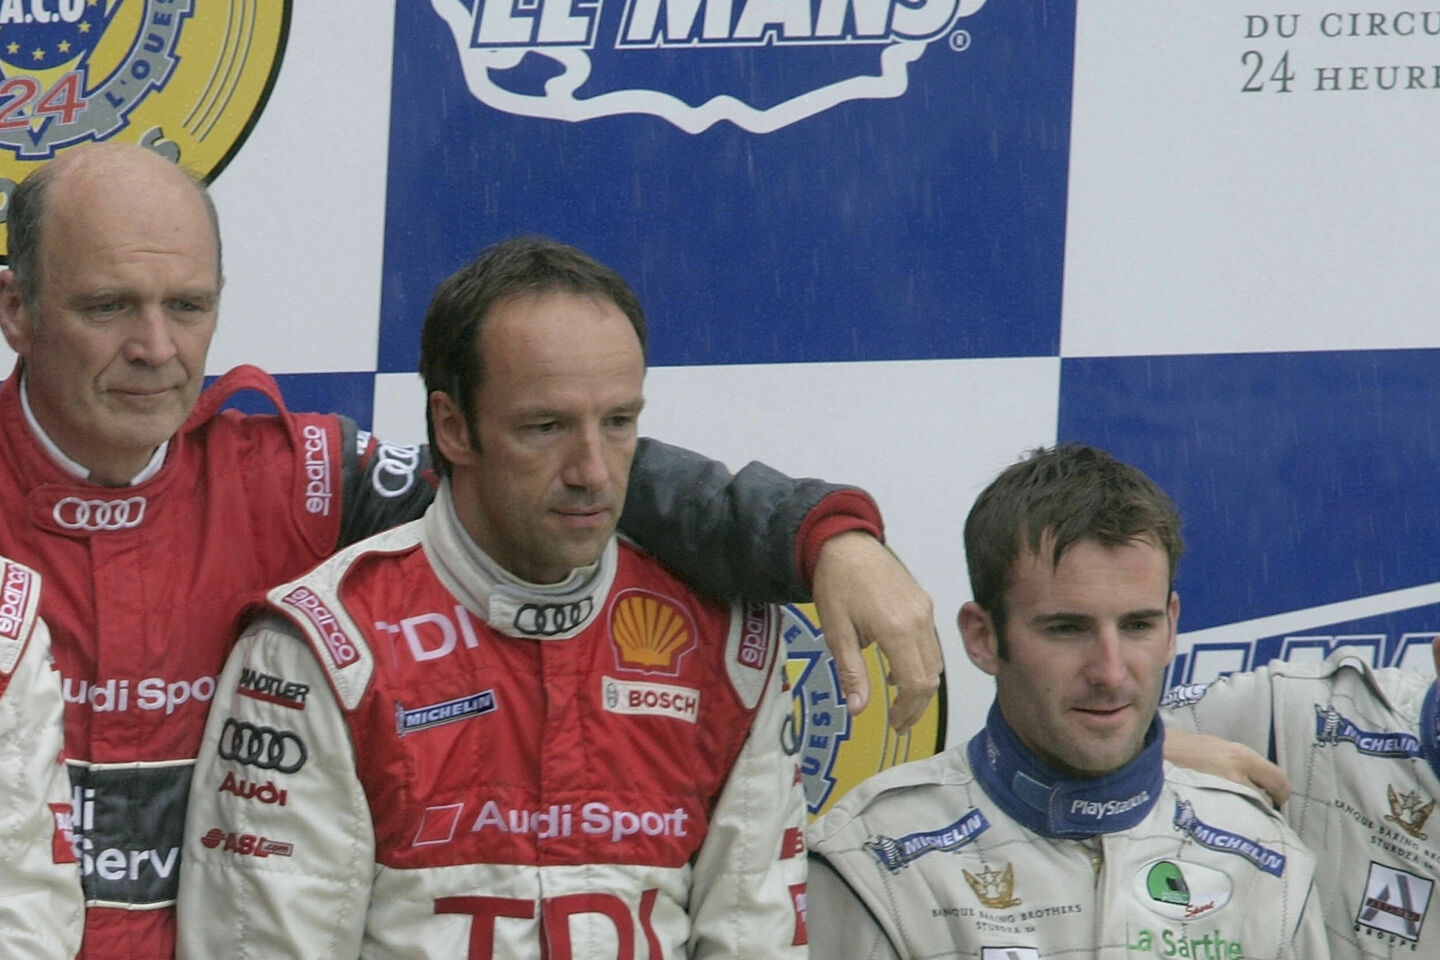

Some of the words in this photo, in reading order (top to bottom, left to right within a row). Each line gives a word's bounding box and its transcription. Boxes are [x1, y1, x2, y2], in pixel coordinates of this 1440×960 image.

[1244, 14, 1301, 38] DU
[1240, 50, 1296, 93] 24
[303, 425, 332, 516] sparco
[291, 587, 358, 666] sparco
[63, 678, 129, 712] udi
[137, 676, 219, 715] Spo
[405, 692, 493, 727] MICHELIN
[628, 690, 696, 713] BOSCH
[471, 800, 572, 839] Audi
[581, 801, 688, 842] Sport
[1194, 824, 1282, 869] MICHELIN
